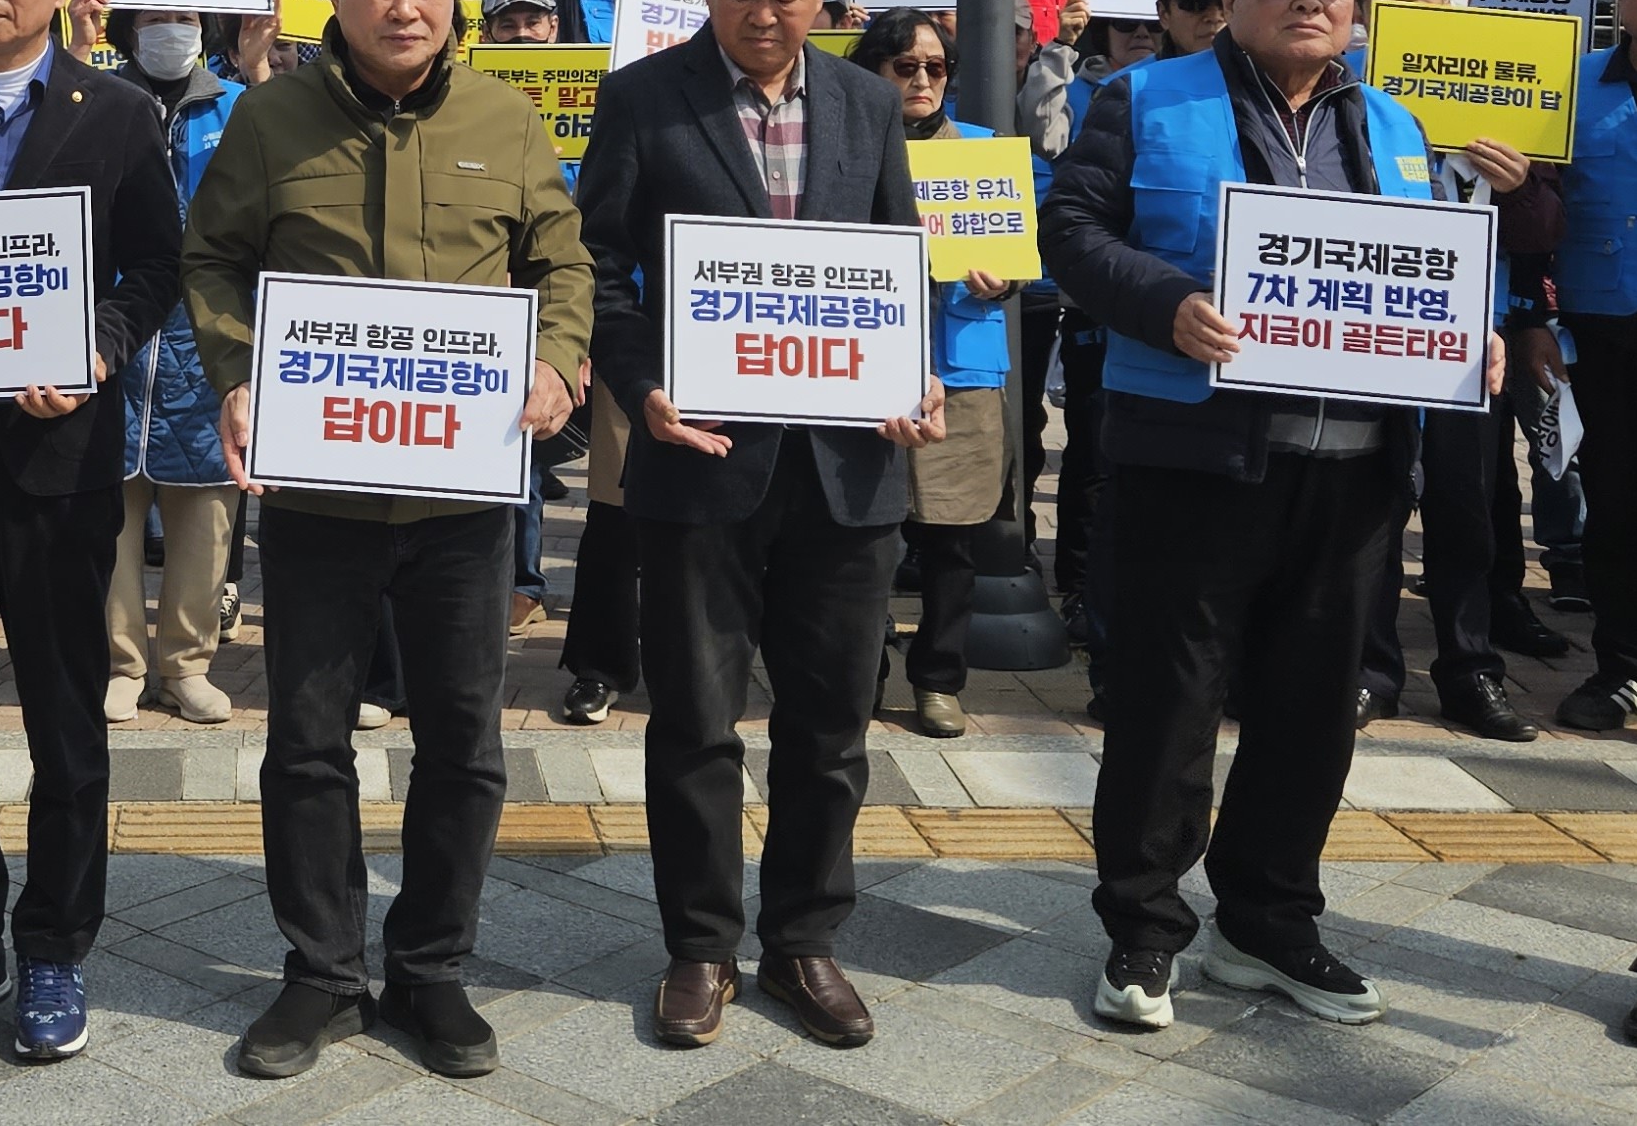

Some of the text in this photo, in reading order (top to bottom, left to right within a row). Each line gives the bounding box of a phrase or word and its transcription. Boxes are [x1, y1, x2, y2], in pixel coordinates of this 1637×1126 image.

[1402, 52, 1542, 85] 일자리와 물류,
[1382, 75, 1562, 111] 경기국제공항이 답
[977, 178, 1021, 200] 유치,
[951, 212, 1024, 236] 화합으로
[694, 259, 898, 294] 서부권 항공 인프라,
[1257, 232, 1459, 281] 경기국제공항
[690, 289, 905, 330] 경기국제공항이
[1246, 272, 1458, 324] 7차 계획 반영,
[284, 319, 502, 358] 서부권 항공 인프라,
[735, 332, 865, 381] 답이다
[1237, 312, 1468, 364] 지금이 골든타임
[279, 349, 509, 397] 경기국제공항이
[322, 396, 462, 450] 답이다
